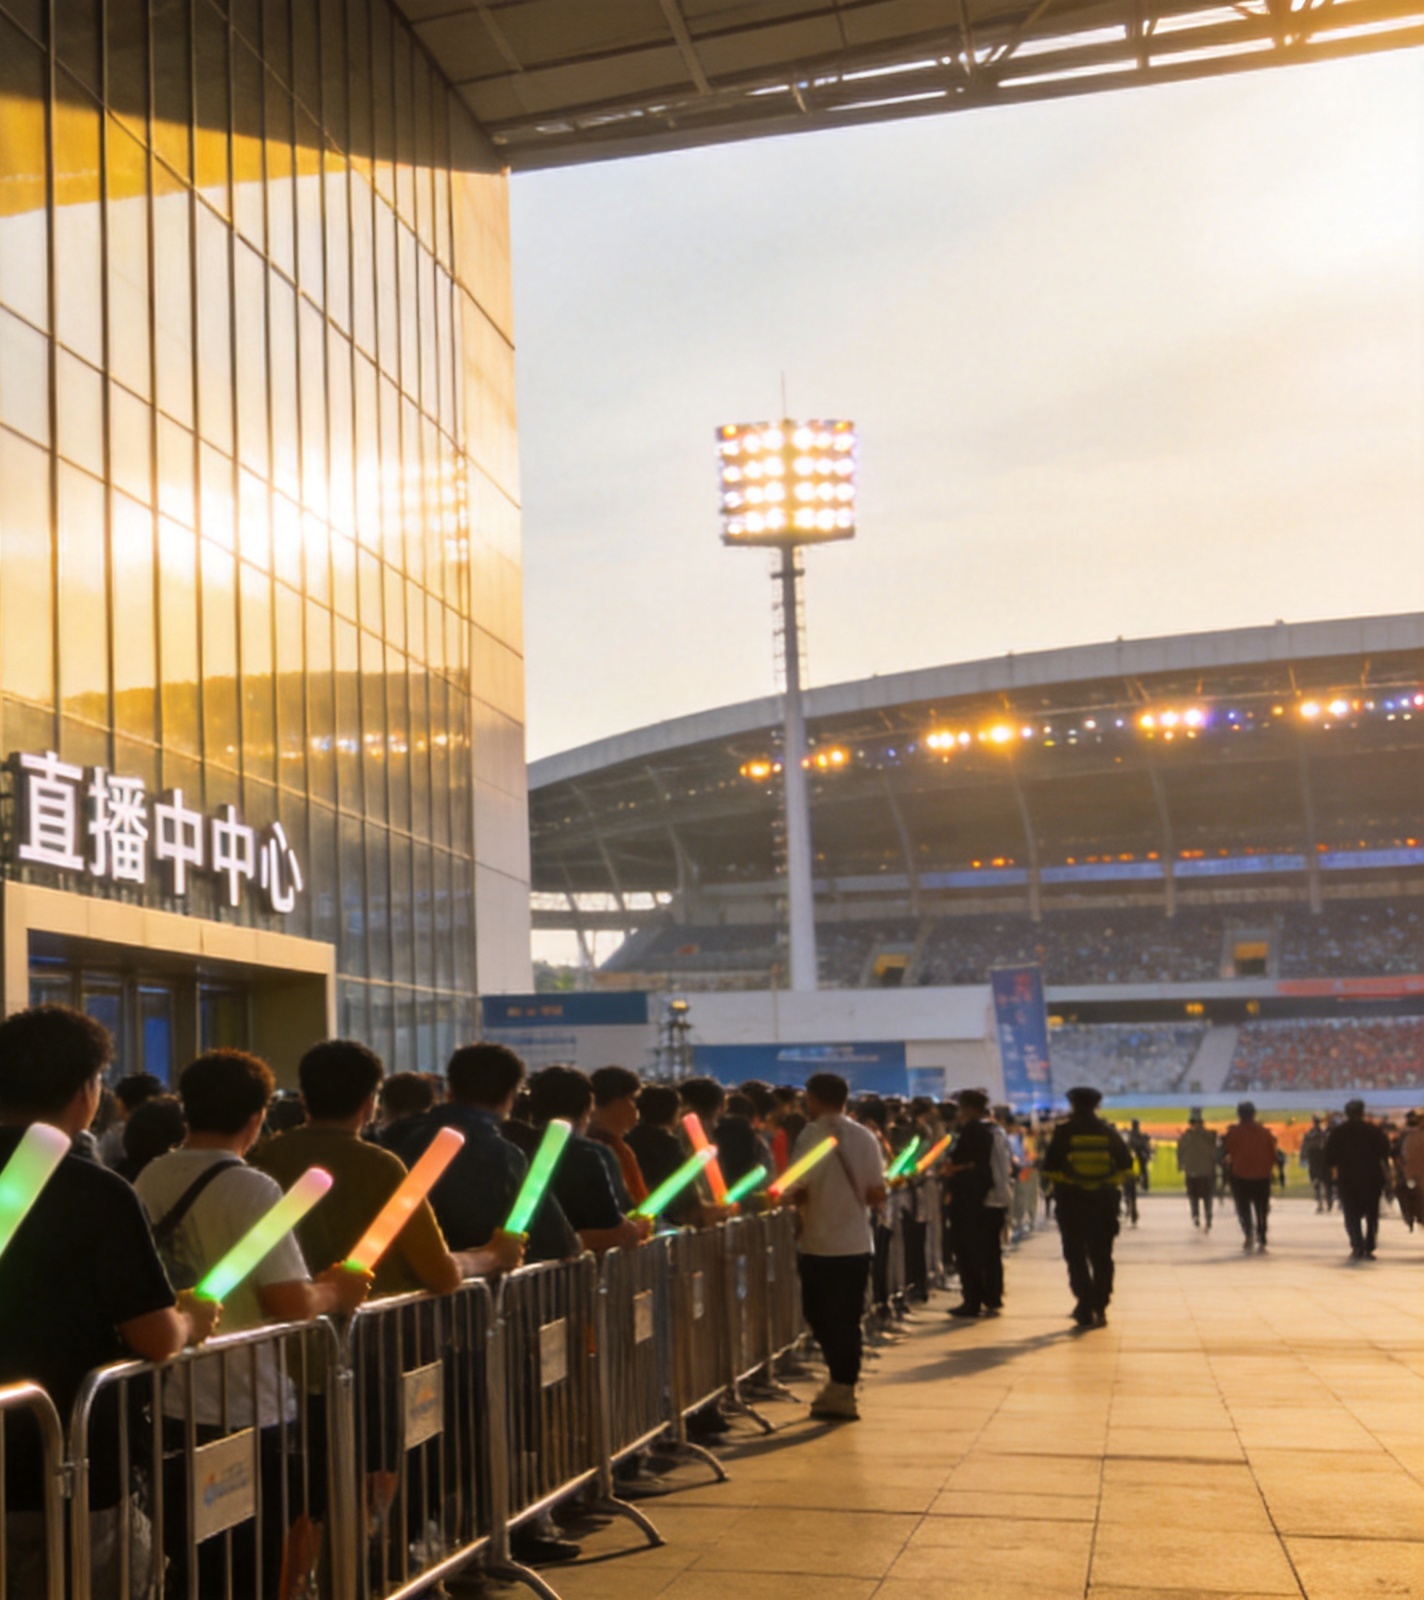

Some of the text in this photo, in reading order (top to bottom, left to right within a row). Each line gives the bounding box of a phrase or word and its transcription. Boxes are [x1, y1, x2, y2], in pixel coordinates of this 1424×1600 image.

[19, 750, 303, 913] 直播中中心
